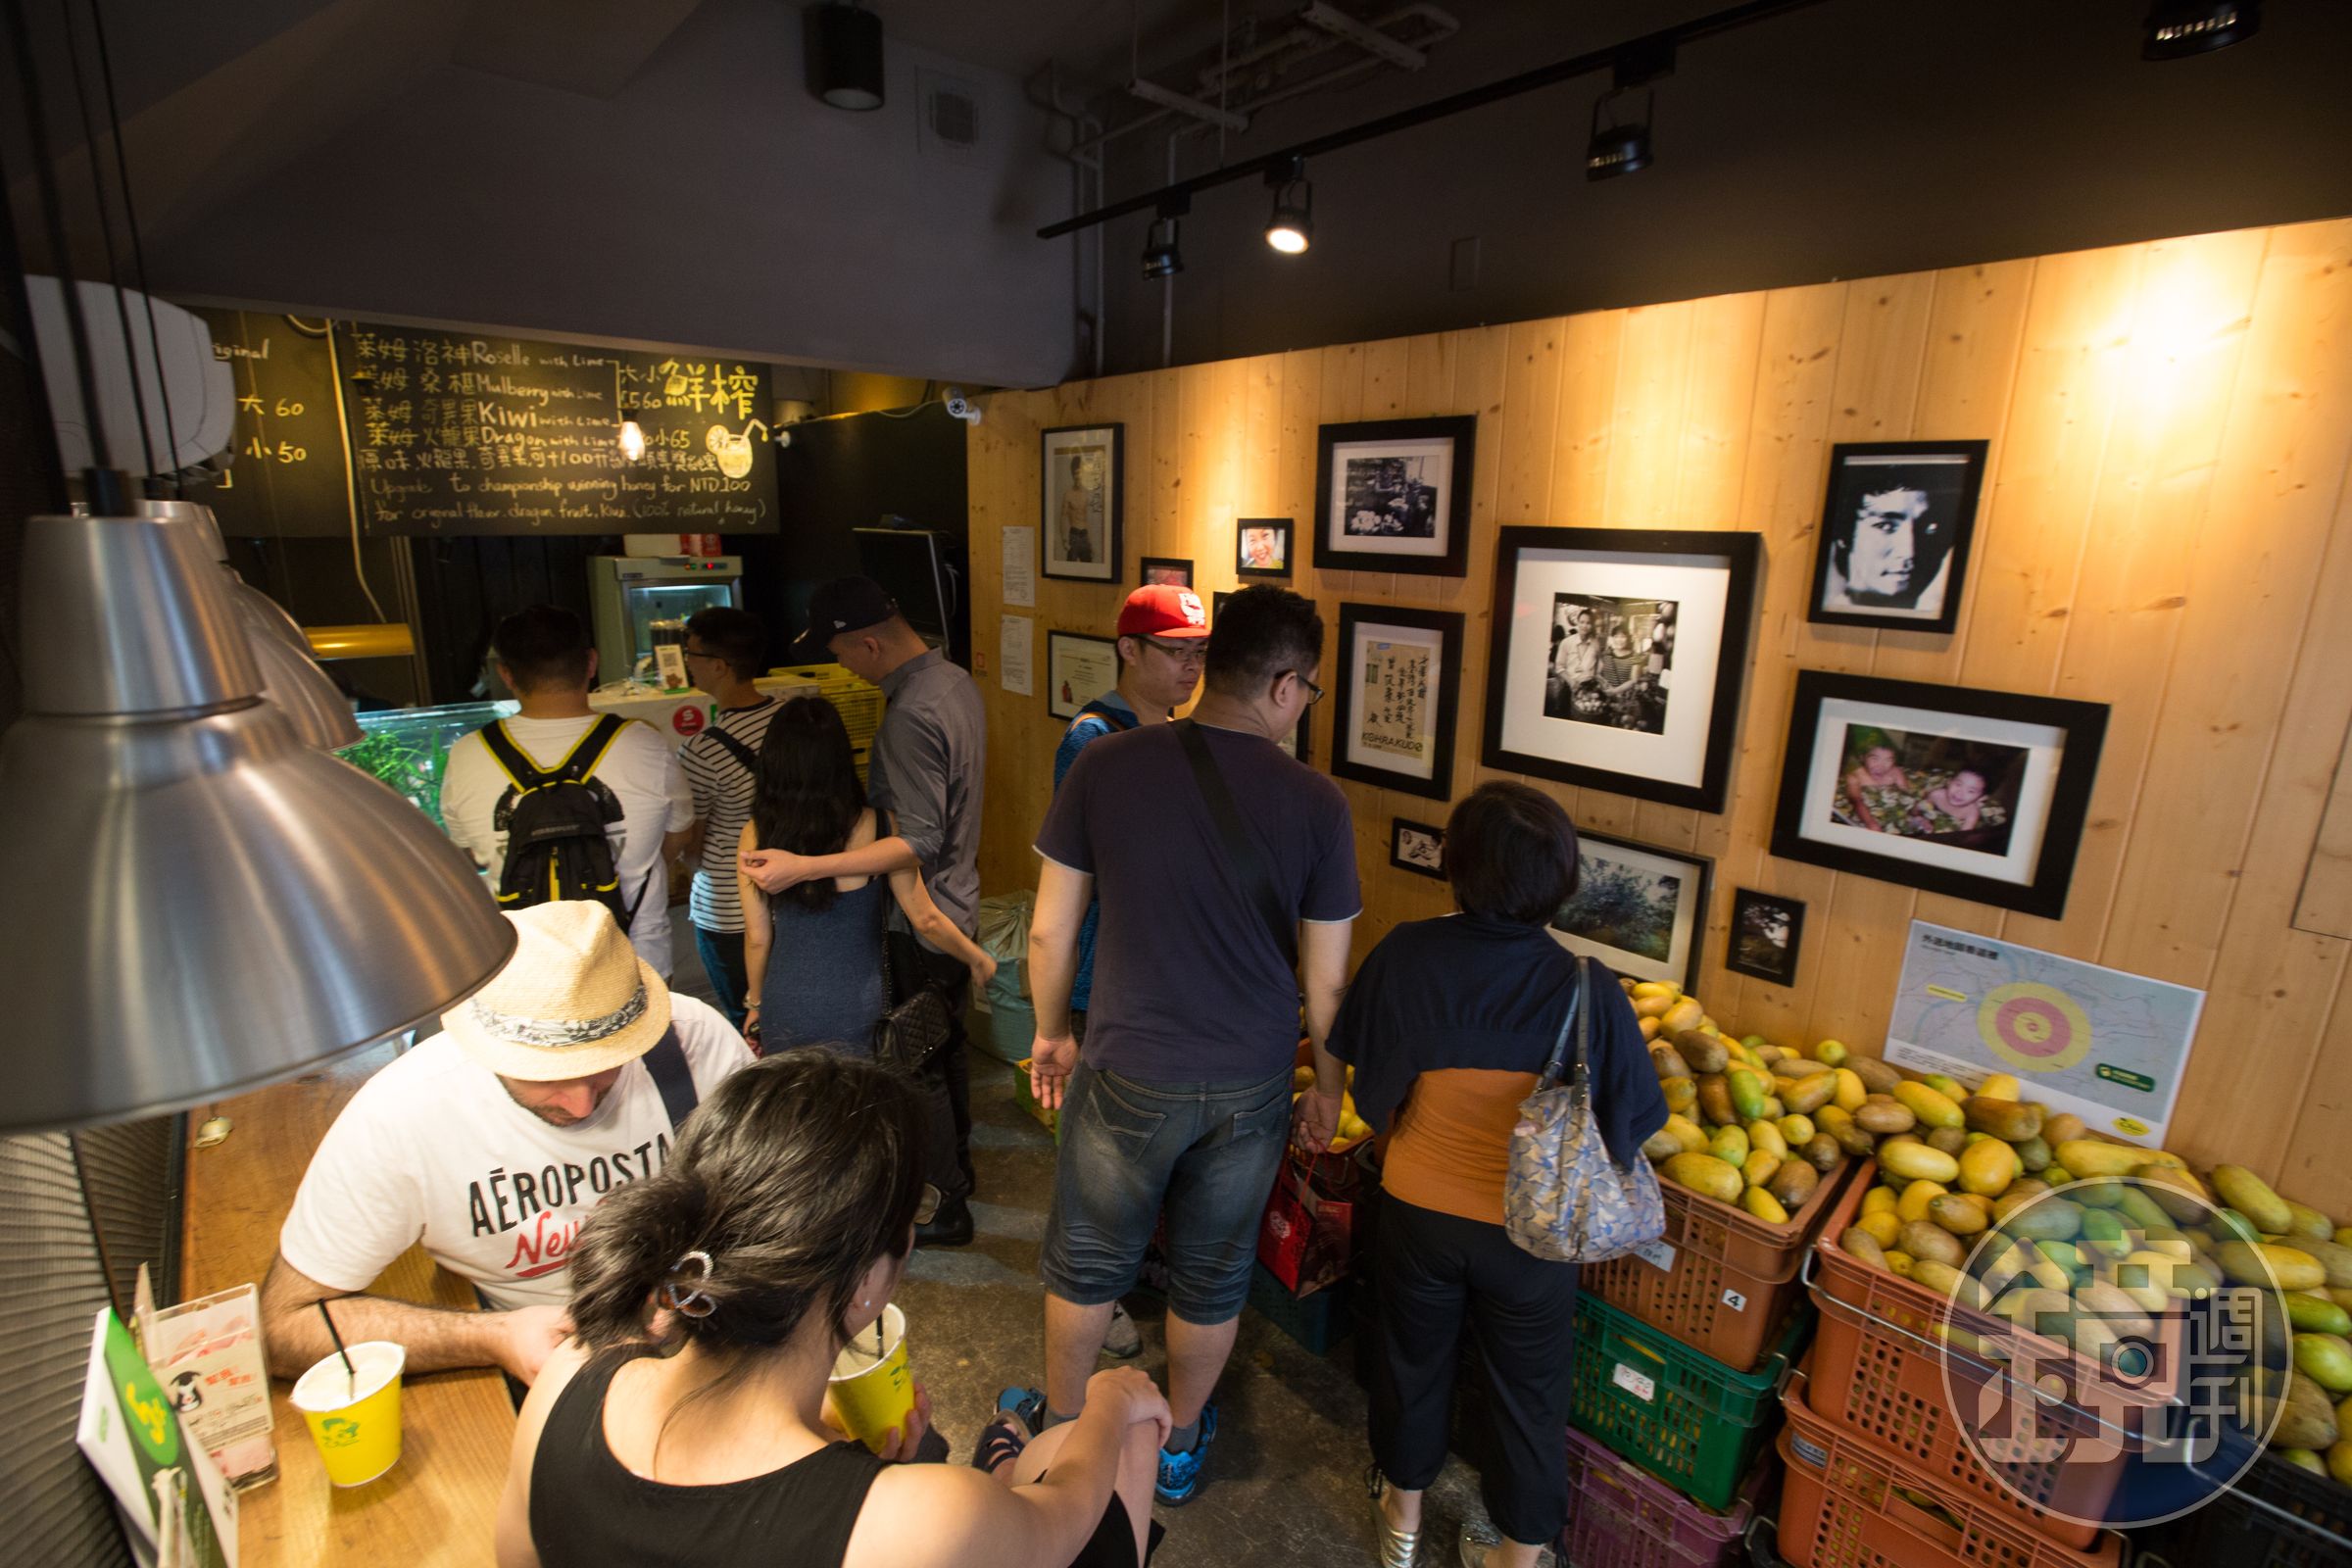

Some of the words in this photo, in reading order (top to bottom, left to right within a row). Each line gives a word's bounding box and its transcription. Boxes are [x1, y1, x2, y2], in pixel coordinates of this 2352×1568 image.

[212, 338, 270, 360] iginal
[472, 340, 530, 367] Roselle
[540, 356, 568, 368] with
[572, 355, 604, 367] Lime
[476, 373, 549, 406] Mulberry
[659, 358, 759, 419] 鮮榨
[238, 394, 265, 415] 大
[275, 398, 304, 416] 60
[478, 401, 537, 427] Kiwi
[540, 416, 573, 426] with
[576, 416, 610, 426] Lime
[246, 437, 272, 459] 小
[278, 441, 307, 464] 50
[481, 426, 548, 451] Dragon
[551, 434, 578, 446] with
[450, 472, 470, 492] to
[620, 474, 656, 500] honey
[660, 475, 685, 492] for
[1728, 1294, 1741, 1308] 4
